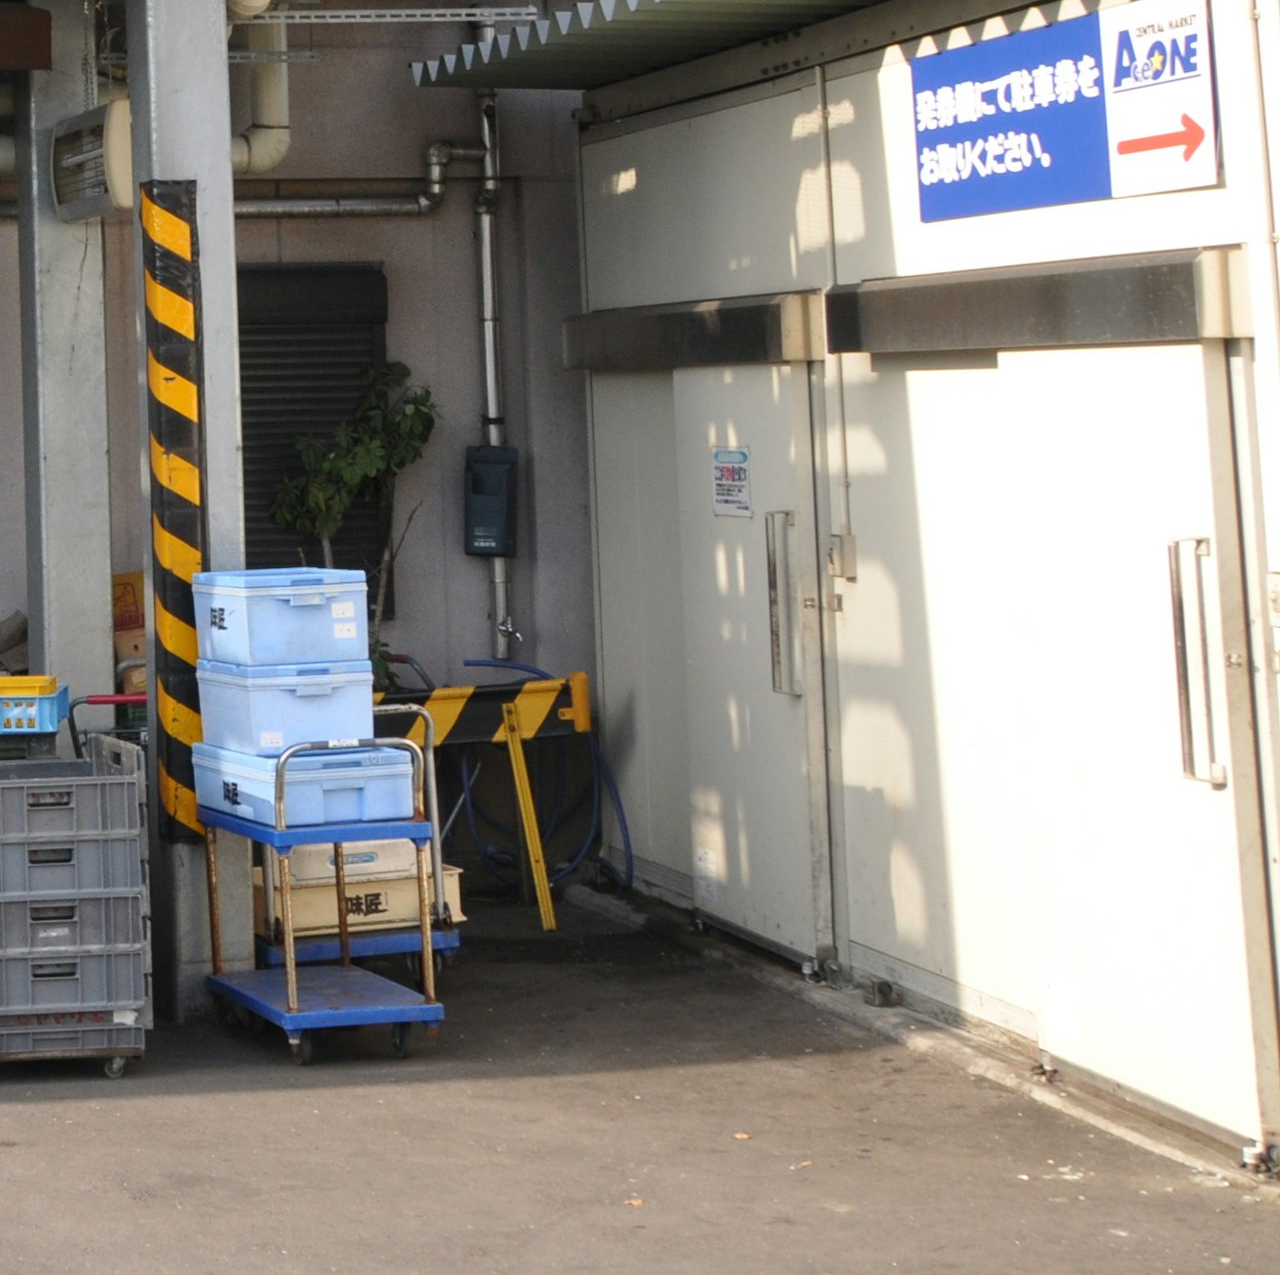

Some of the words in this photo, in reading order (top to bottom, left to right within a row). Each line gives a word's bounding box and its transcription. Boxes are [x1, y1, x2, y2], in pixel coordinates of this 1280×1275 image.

[920, 130, 1051, 185] お取りください。
